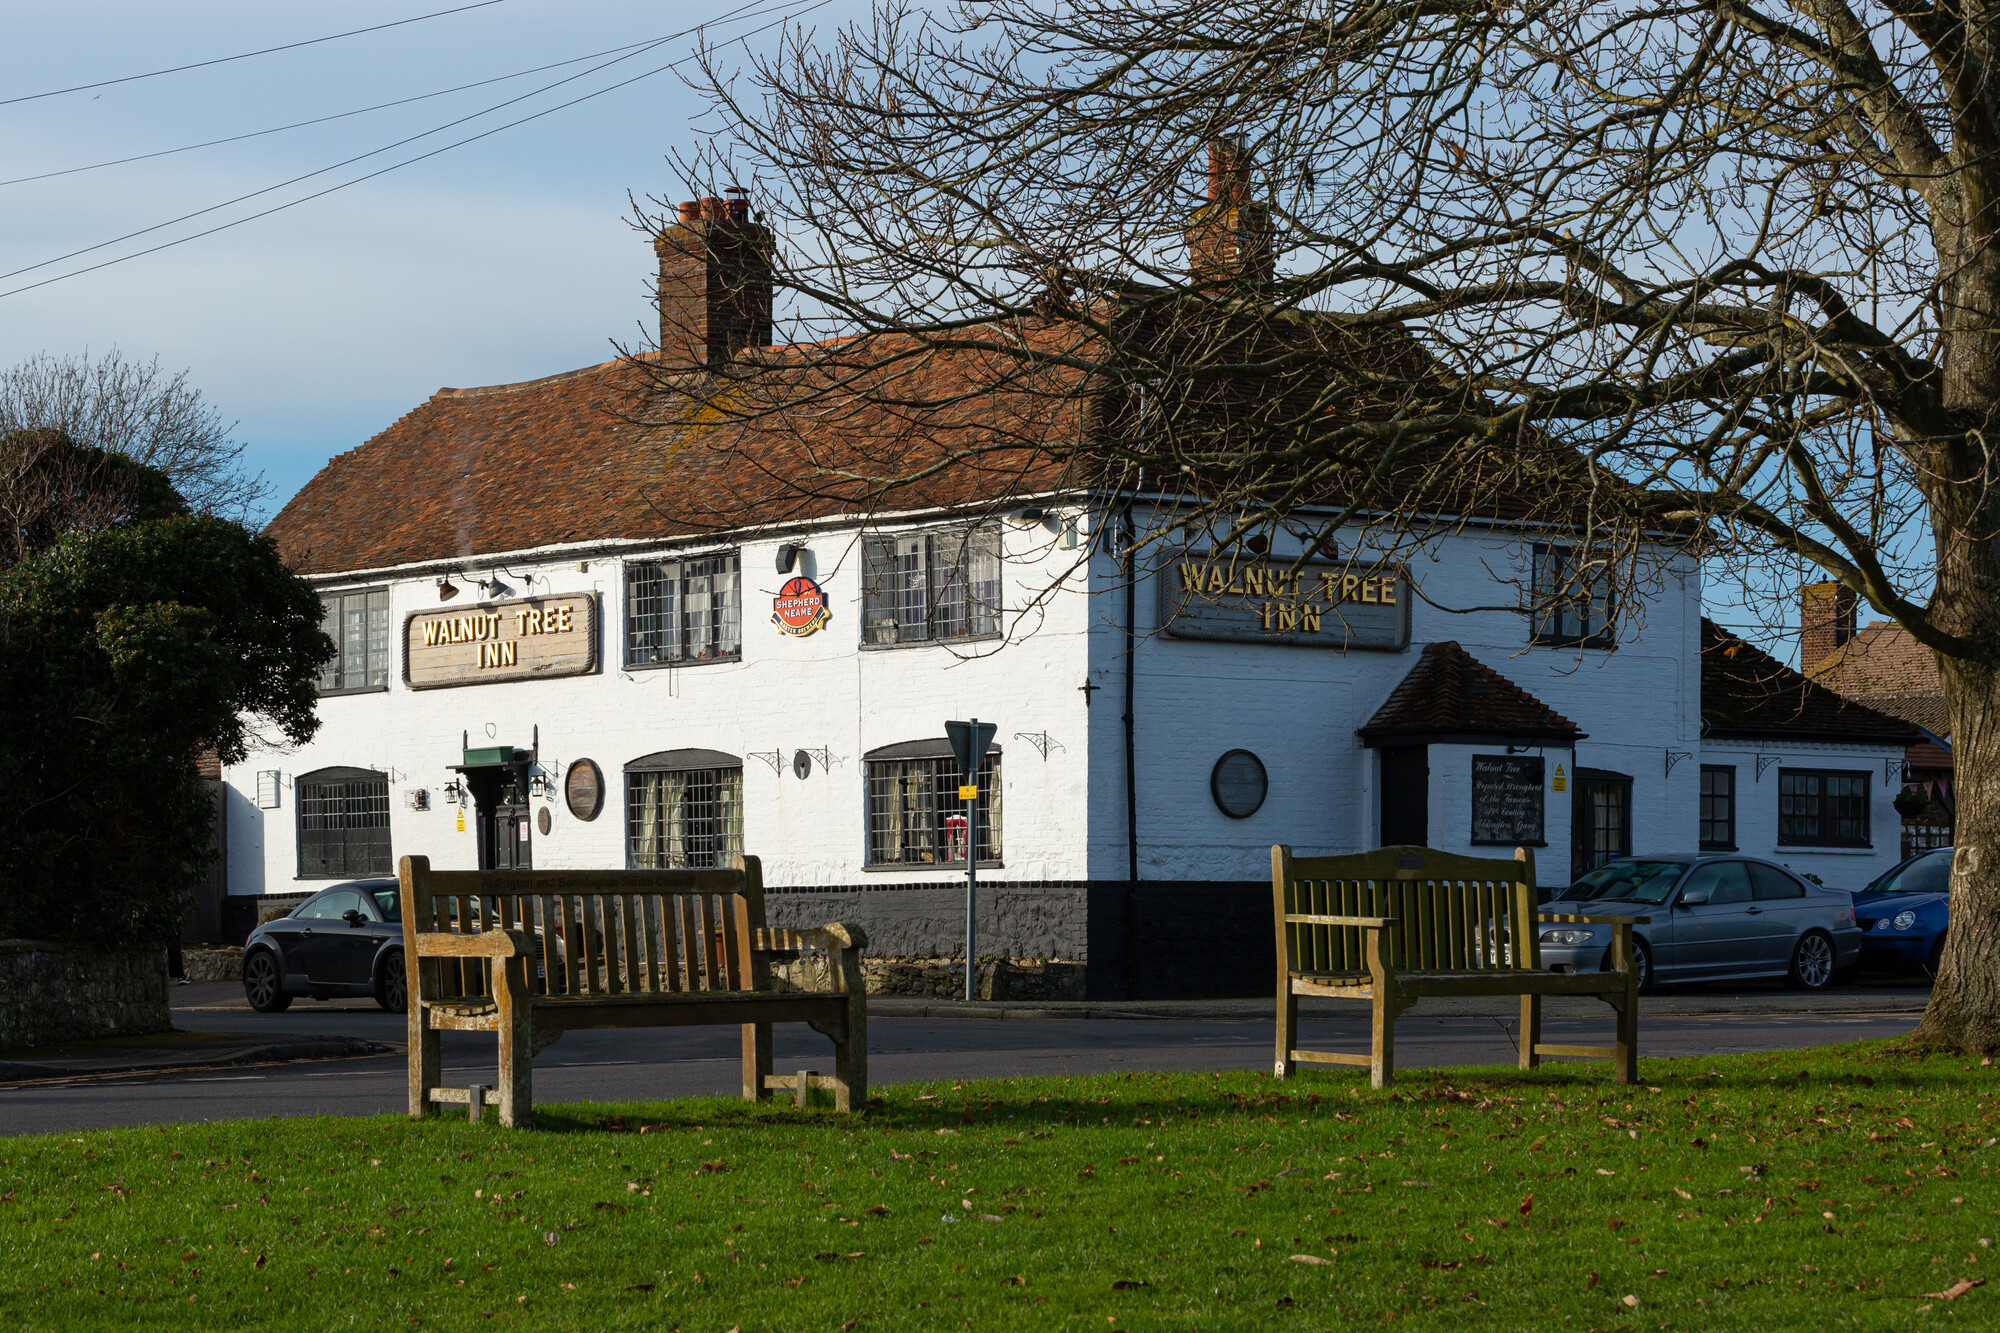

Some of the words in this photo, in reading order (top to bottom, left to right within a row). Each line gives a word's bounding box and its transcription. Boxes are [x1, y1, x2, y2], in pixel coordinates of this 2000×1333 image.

[1180, 563, 1304, 596] WALNUT
[1321, 572, 1397, 604] TREE
[776, 597, 820, 609] SHEPHERD
[784, 608, 812, 618] NEAME
[1263, 602, 1321, 632] INN
[424, 613, 500, 646] WALNUT
[516, 605, 573, 636] TREE
[478, 640, 516, 669] INN
[1475, 761, 1503, 772] Walnut
[1504, 762, 1520, 773] Tree
[1474, 780, 1504, 792] Reputed
[1479, 795, 1486, 804] of
[1489, 793, 1500, 803] the
[1516, 820, 1536, 832] Gang
[482, 877, 533, 890] Aldington
[536, 878, 555, 888] and
[558, 877, 619, 890] Bonnington
[656, 875, 696, 888] Council
